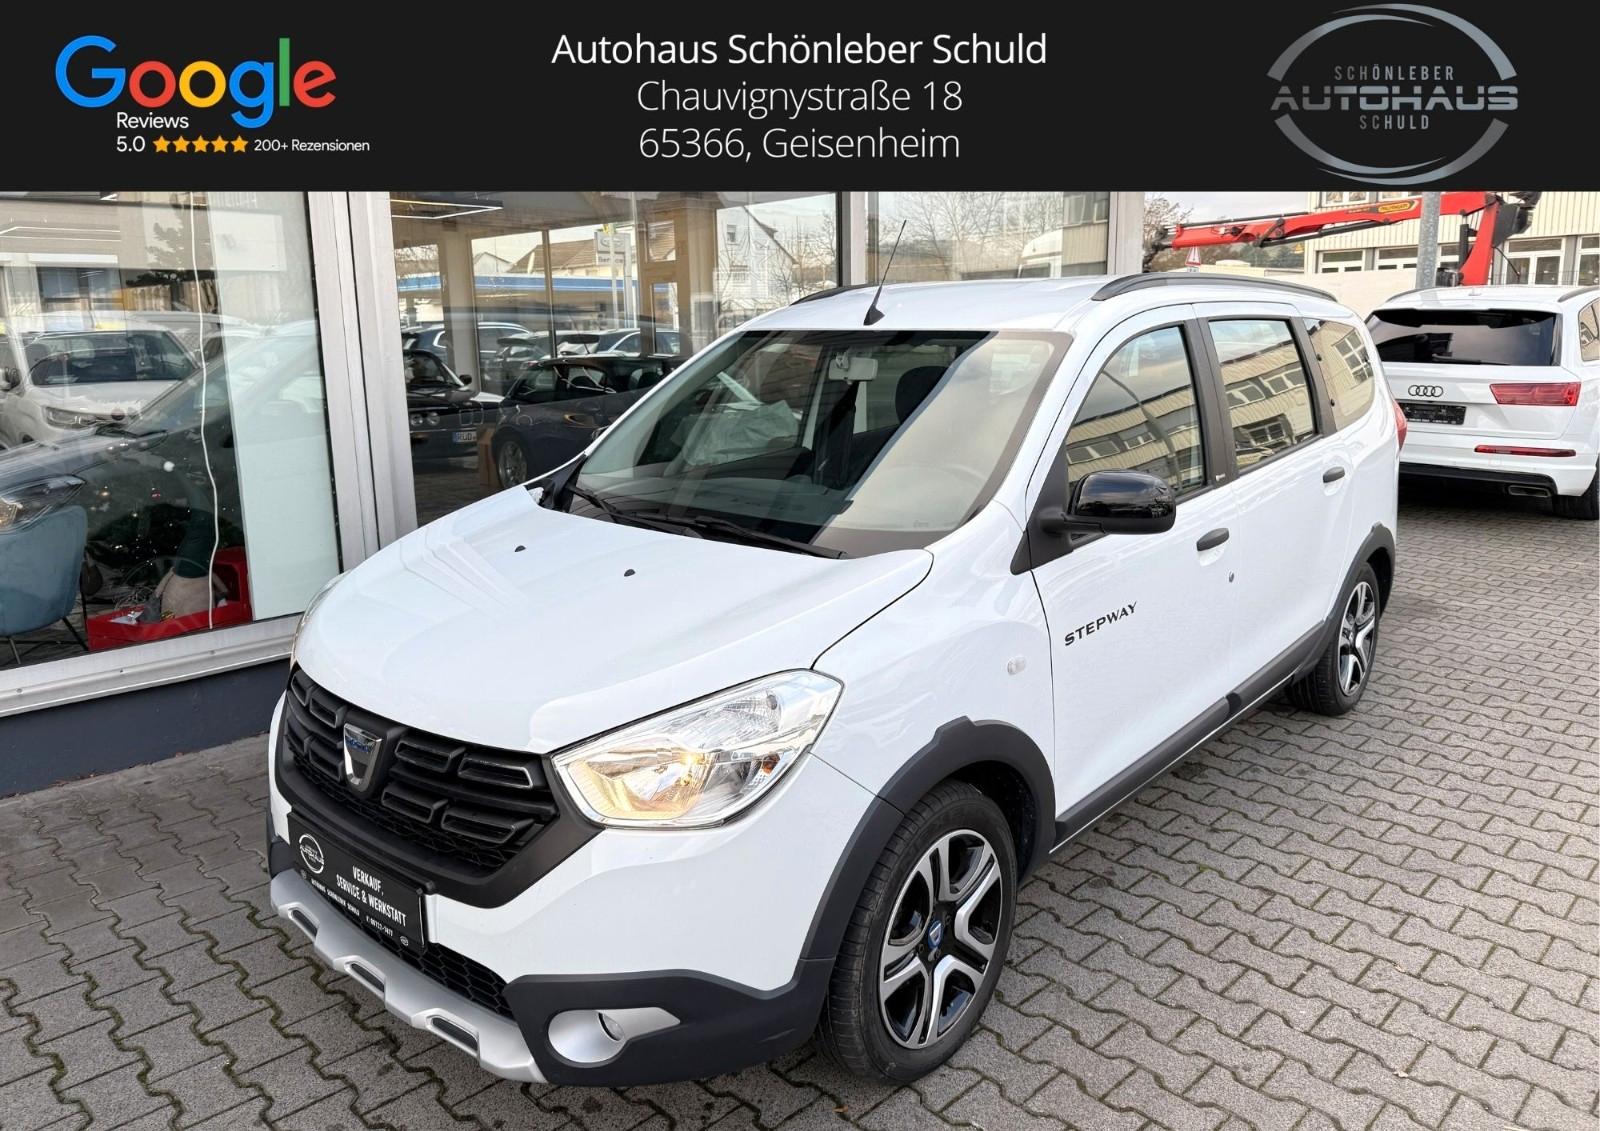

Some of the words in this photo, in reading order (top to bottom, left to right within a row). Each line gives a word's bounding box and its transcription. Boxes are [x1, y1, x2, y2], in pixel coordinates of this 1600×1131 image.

[1064, 601, 1137, 646] STEPWAY
[336, 873, 361, 900] SERVICE
[361, 890, 368, 904] &
[368, 894, 406, 927] WERKSTATT
[352, 865, 384, 896] VERKAUF,
